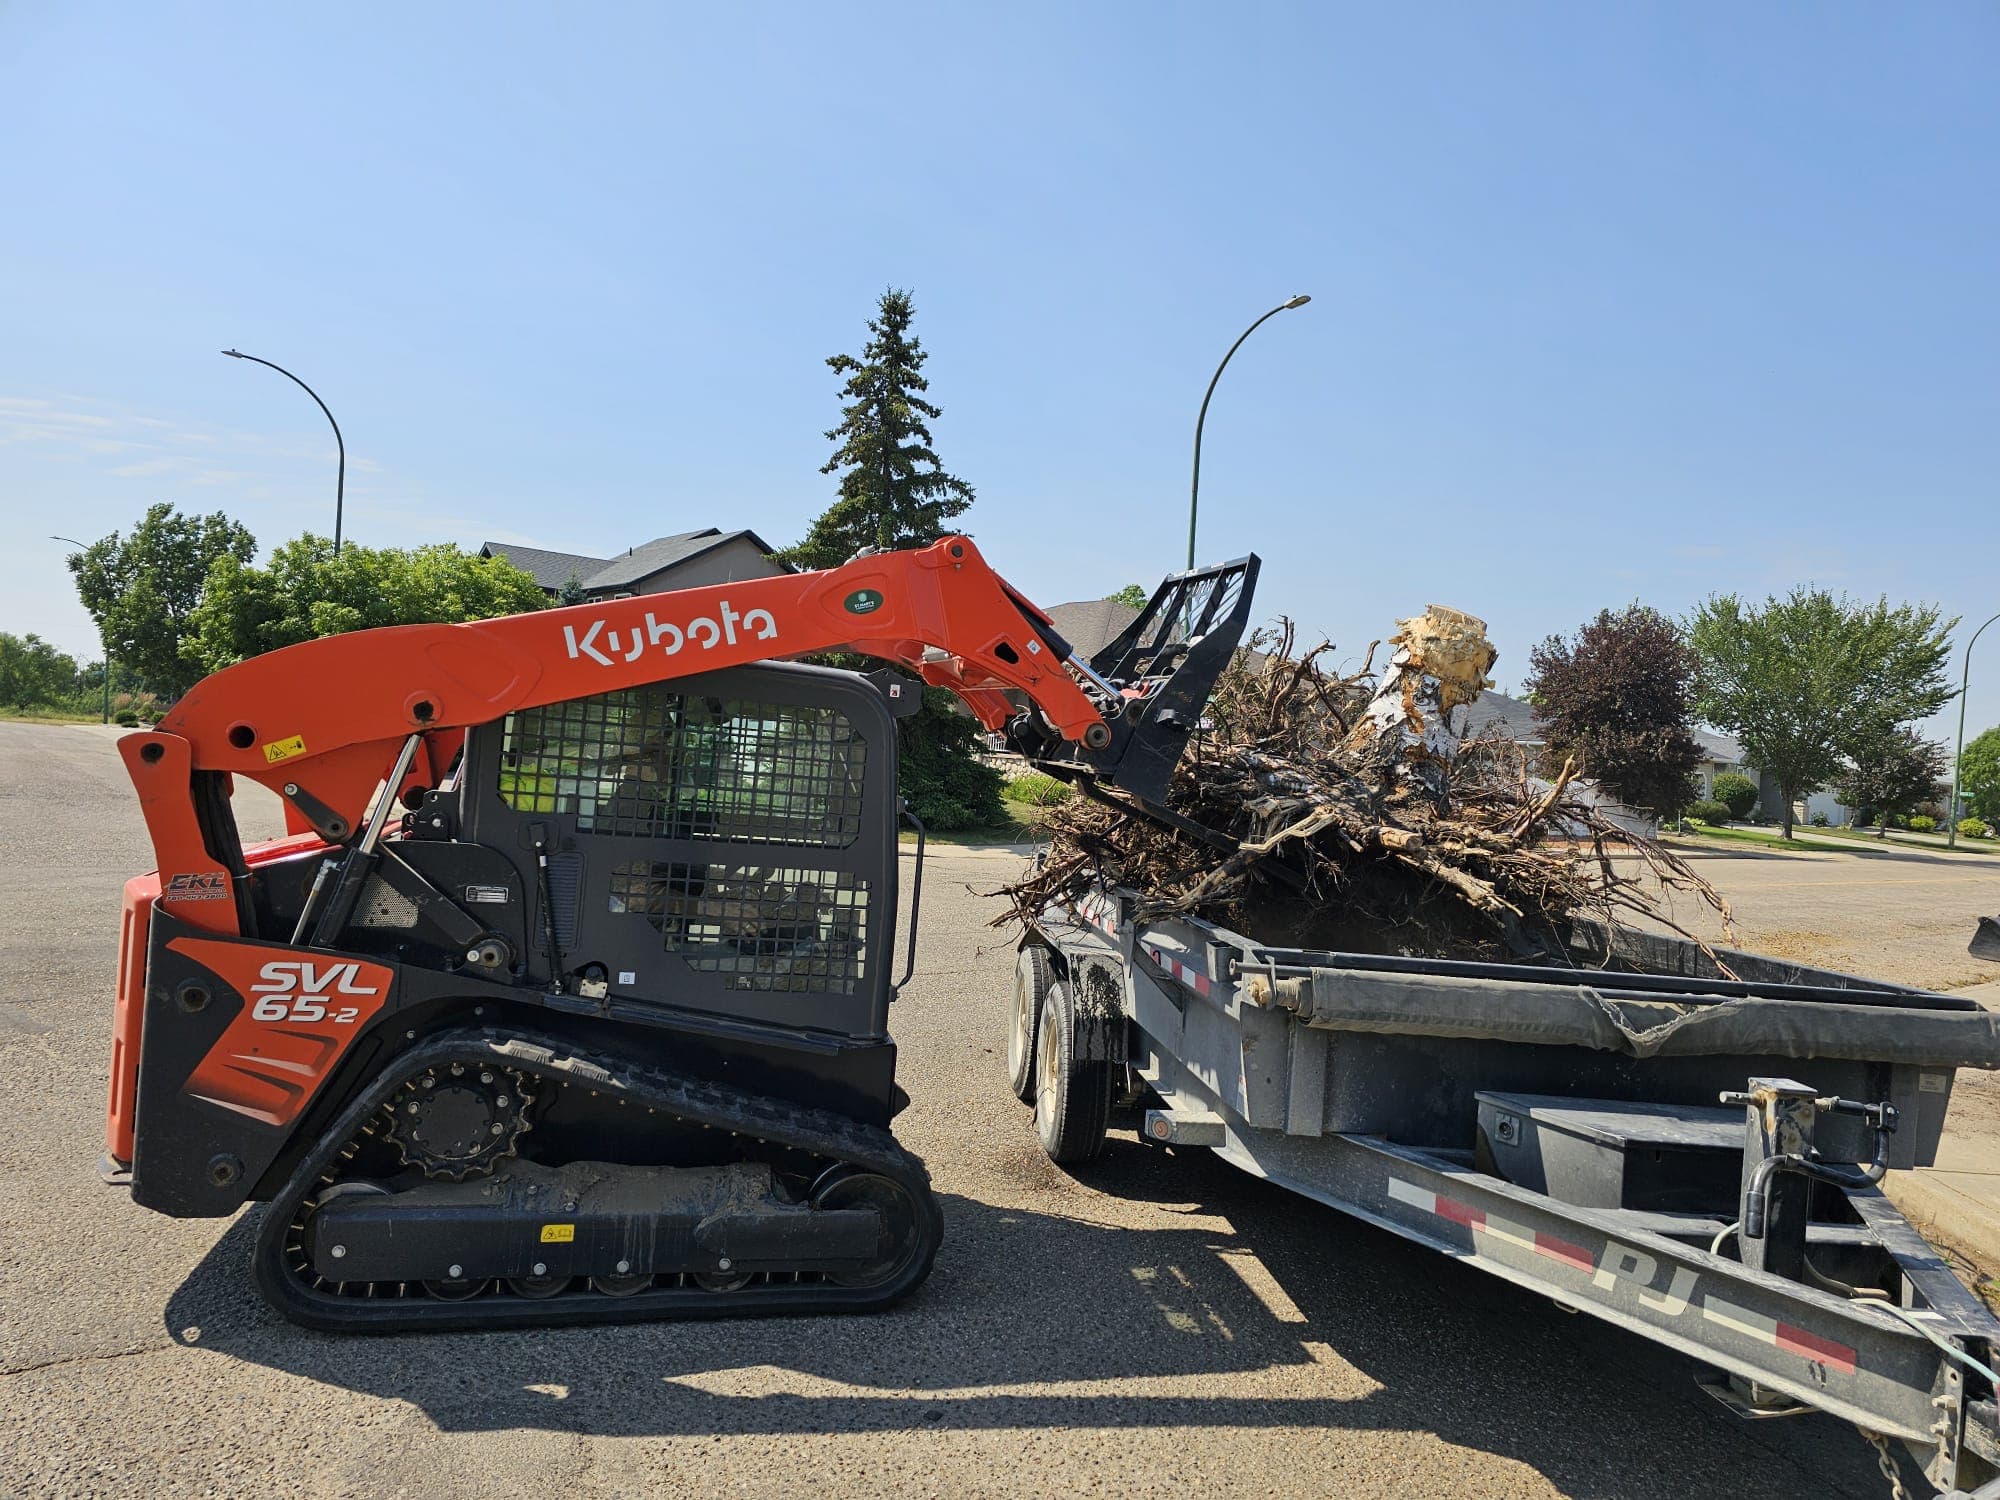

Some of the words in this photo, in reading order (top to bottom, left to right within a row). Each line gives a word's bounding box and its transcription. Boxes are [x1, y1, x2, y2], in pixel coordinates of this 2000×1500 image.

[563, 600, 778, 666] Kubota
[250, 962, 378, 995] SVL
[251, 994, 360, 1024] 65-2
[1592, 1239, 1700, 1316] PJ
